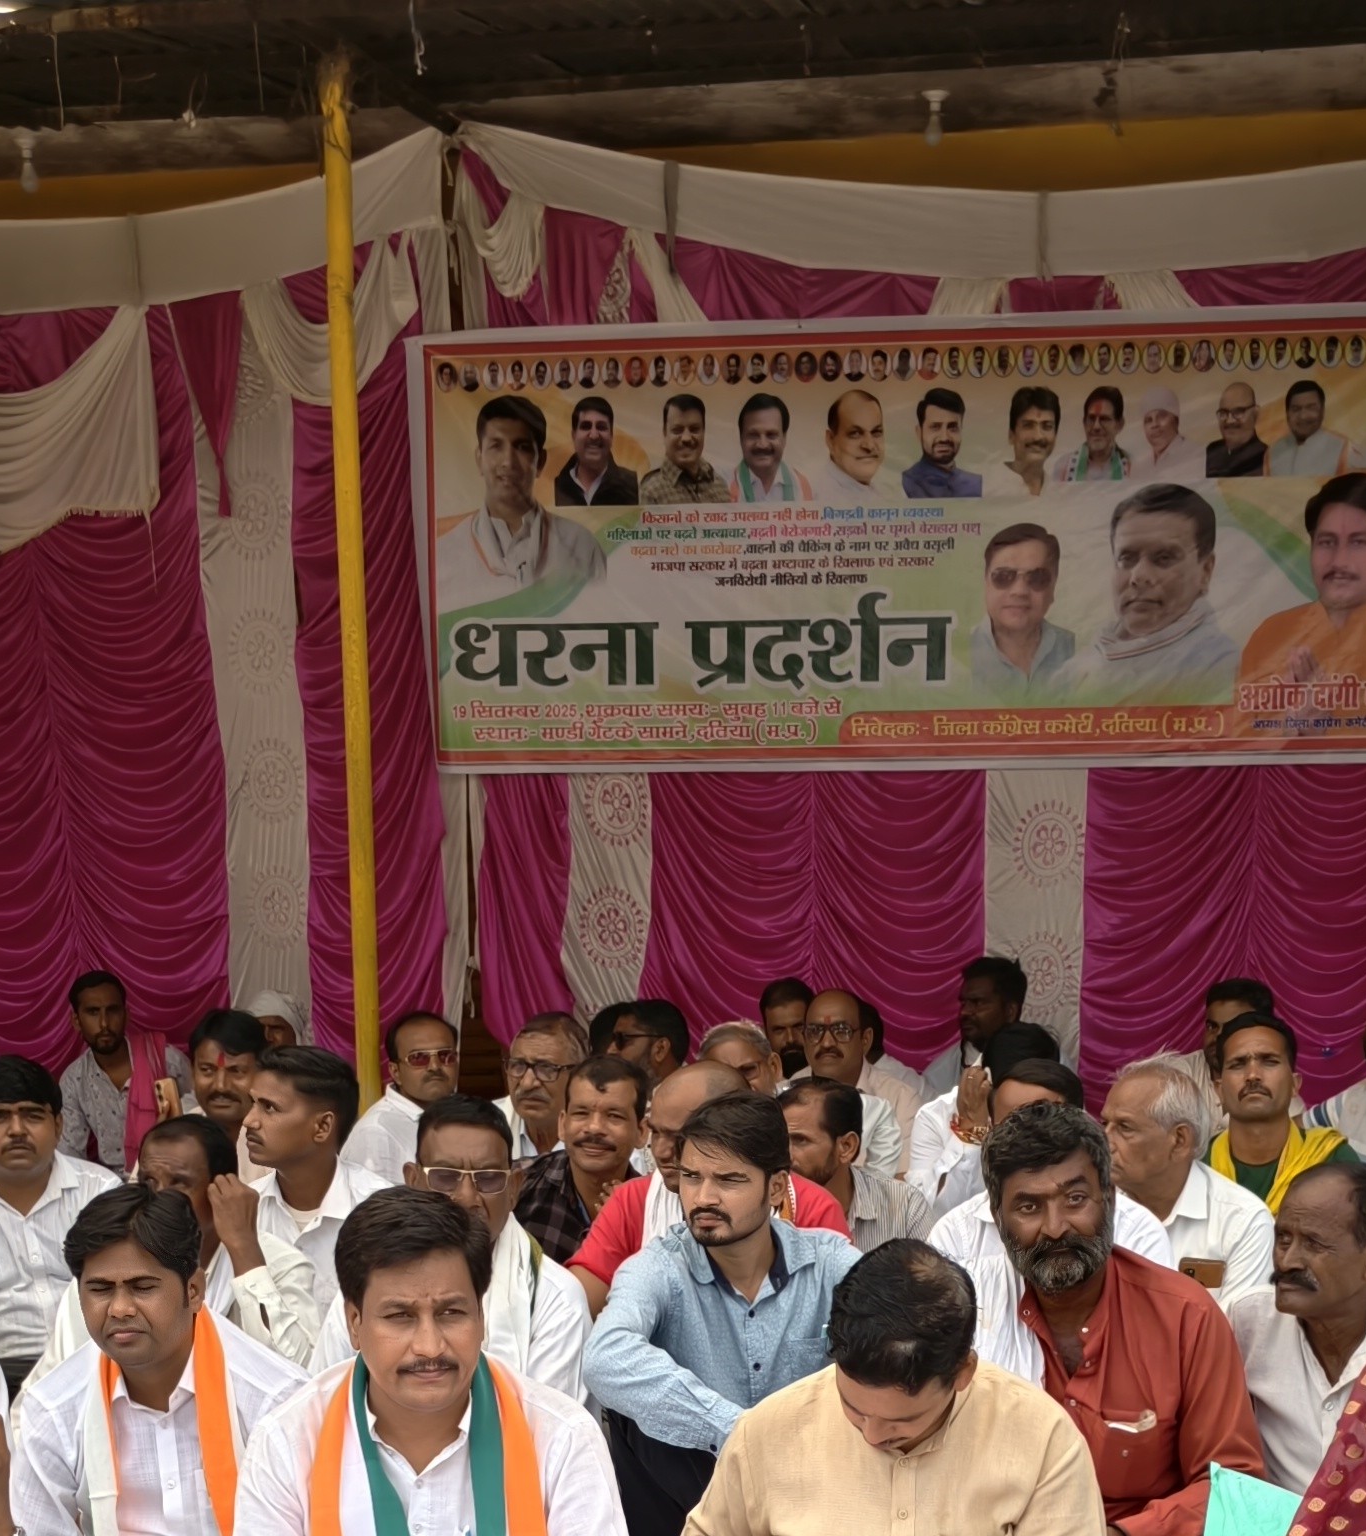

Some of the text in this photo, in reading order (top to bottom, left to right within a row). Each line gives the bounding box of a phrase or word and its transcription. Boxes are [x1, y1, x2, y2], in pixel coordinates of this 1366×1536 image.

[685, 509, 700, 523] को
[703, 512, 727, 522] खाद
[867, 508, 900, 522] कानून
[903, 507, 944, 519] व्यवस्था
[656, 529, 671, 540] पर
[872, 524, 887, 535] पर
[780, 539, 795, 553] की
[834, 538, 846, 551] के
[849, 540, 870, 551] नाम
[874, 540, 889, 551] पर
[893, 538, 920, 551] अवैध
[923, 537, 955, 553] वसूली
[651, 560, 686, 571] भाजपा
[689, 560, 725, 571] सरकार
[818, 556, 830, 568] के
[833, 554, 875, 568] खिलाफ
[878, 554, 894, 567] एवं
[897, 556, 935, 567] सरकार
[715, 573, 767, 587] जनविरोधी
[811, 570, 823, 585] के
[826, 570, 868, 586] खिलाफ
[454, 592, 951, 690] धरना प्रदर्शन
[1239, 675, 1307, 710] अशोक
[1310, 674, 1360, 709] दांगी
[453, 704, 467, 718] 19
[470, 699, 541, 719] सितम्बर
[721, 701, 767, 722] सुबह
[771, 702, 786, 716] 11
[789, 697, 820, 717] बजे
[823, 696, 841, 715] से
[541, 720, 584, 740] मण्डी
[696, 719, 752, 740] दतिया
[934, 715, 979, 737] जिला
[1101, 711, 1158, 735] दतिया
